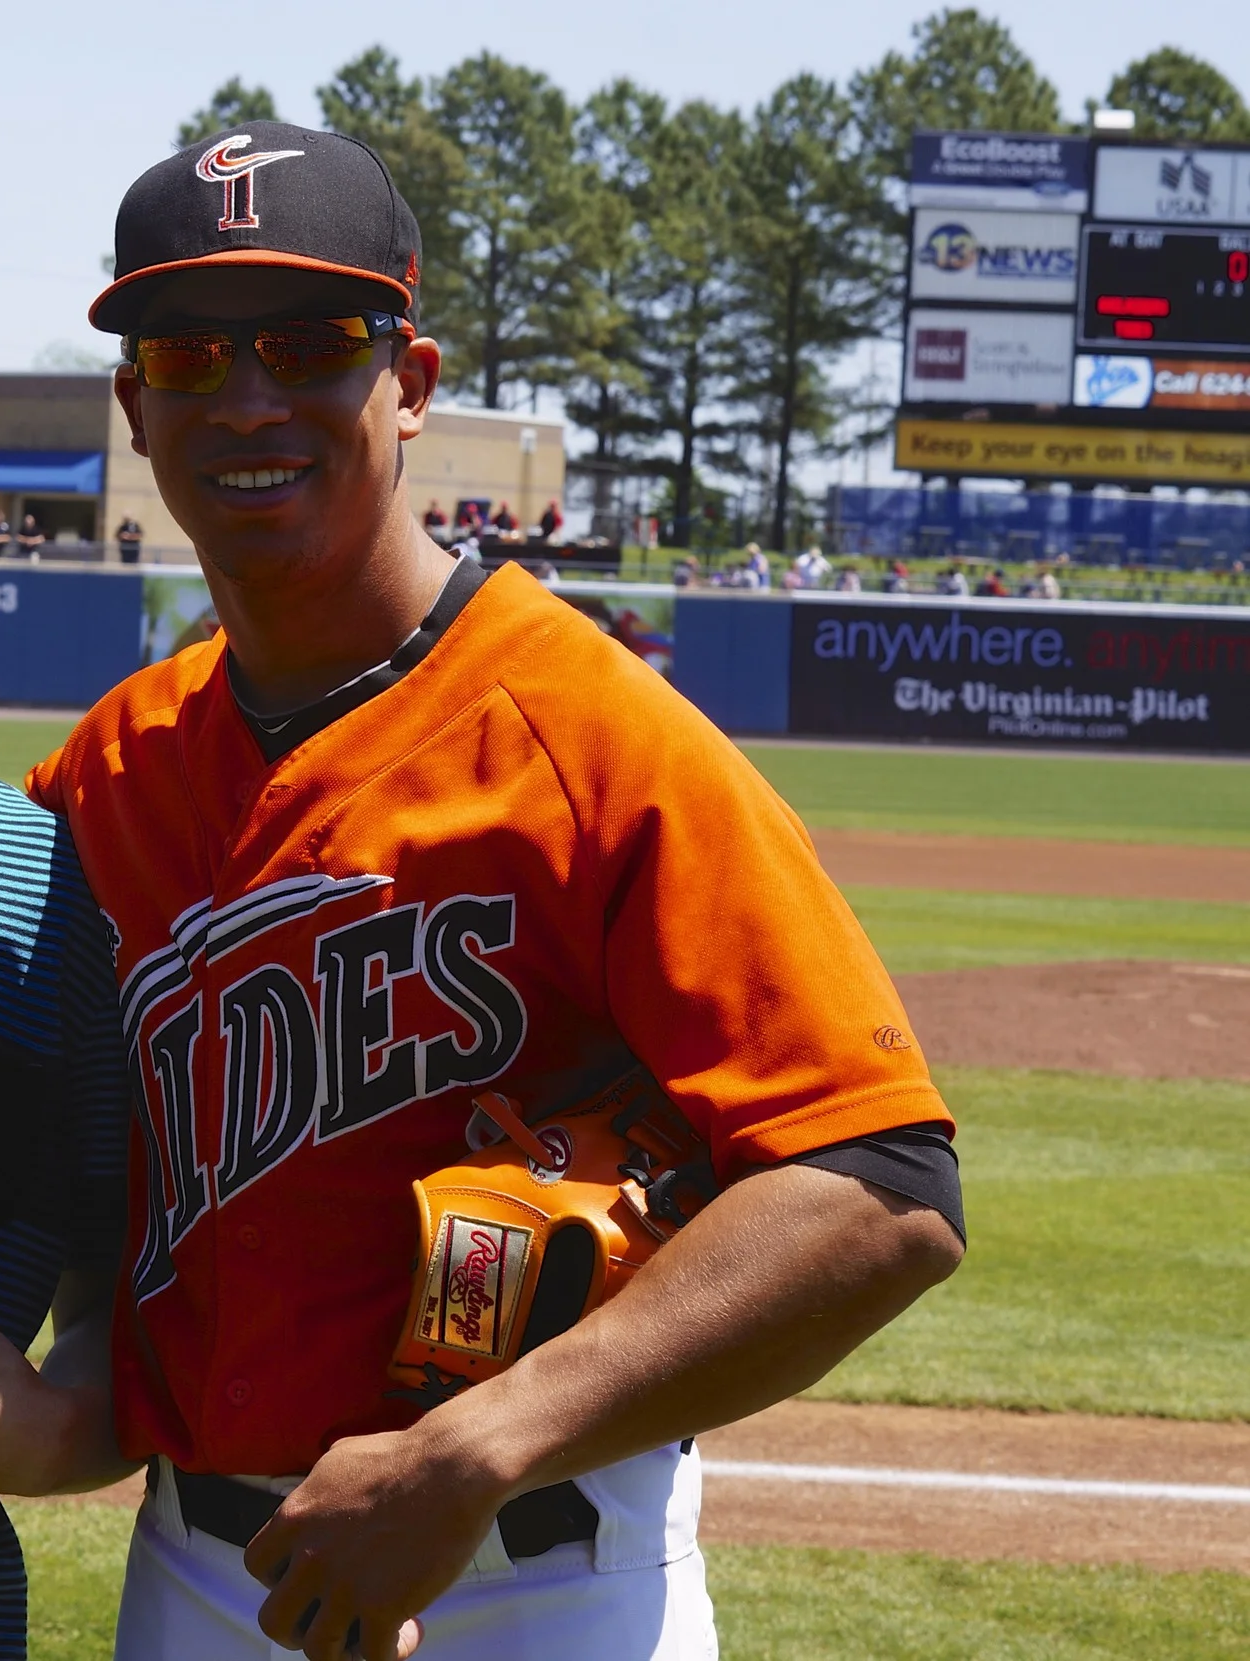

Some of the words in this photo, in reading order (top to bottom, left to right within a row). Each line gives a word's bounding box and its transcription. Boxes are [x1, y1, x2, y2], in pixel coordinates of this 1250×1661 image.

[940, 135, 1061, 163] EcoBoost
[1154, 370, 1199, 394] Call
[911, 433, 972, 461] Keep
[980, 442, 1034, 463] your
[1044, 444, 1088, 466] eye
[1096, 445, 1126, 462] on
[1135, 442, 1175, 465] the
[814, 611, 1074, 673] anywhere.
[894, 677, 955, 716] The
[960, 681, 1210, 724] Virginian-Pilot
[449, 1230, 499, 1344] Rawlings
